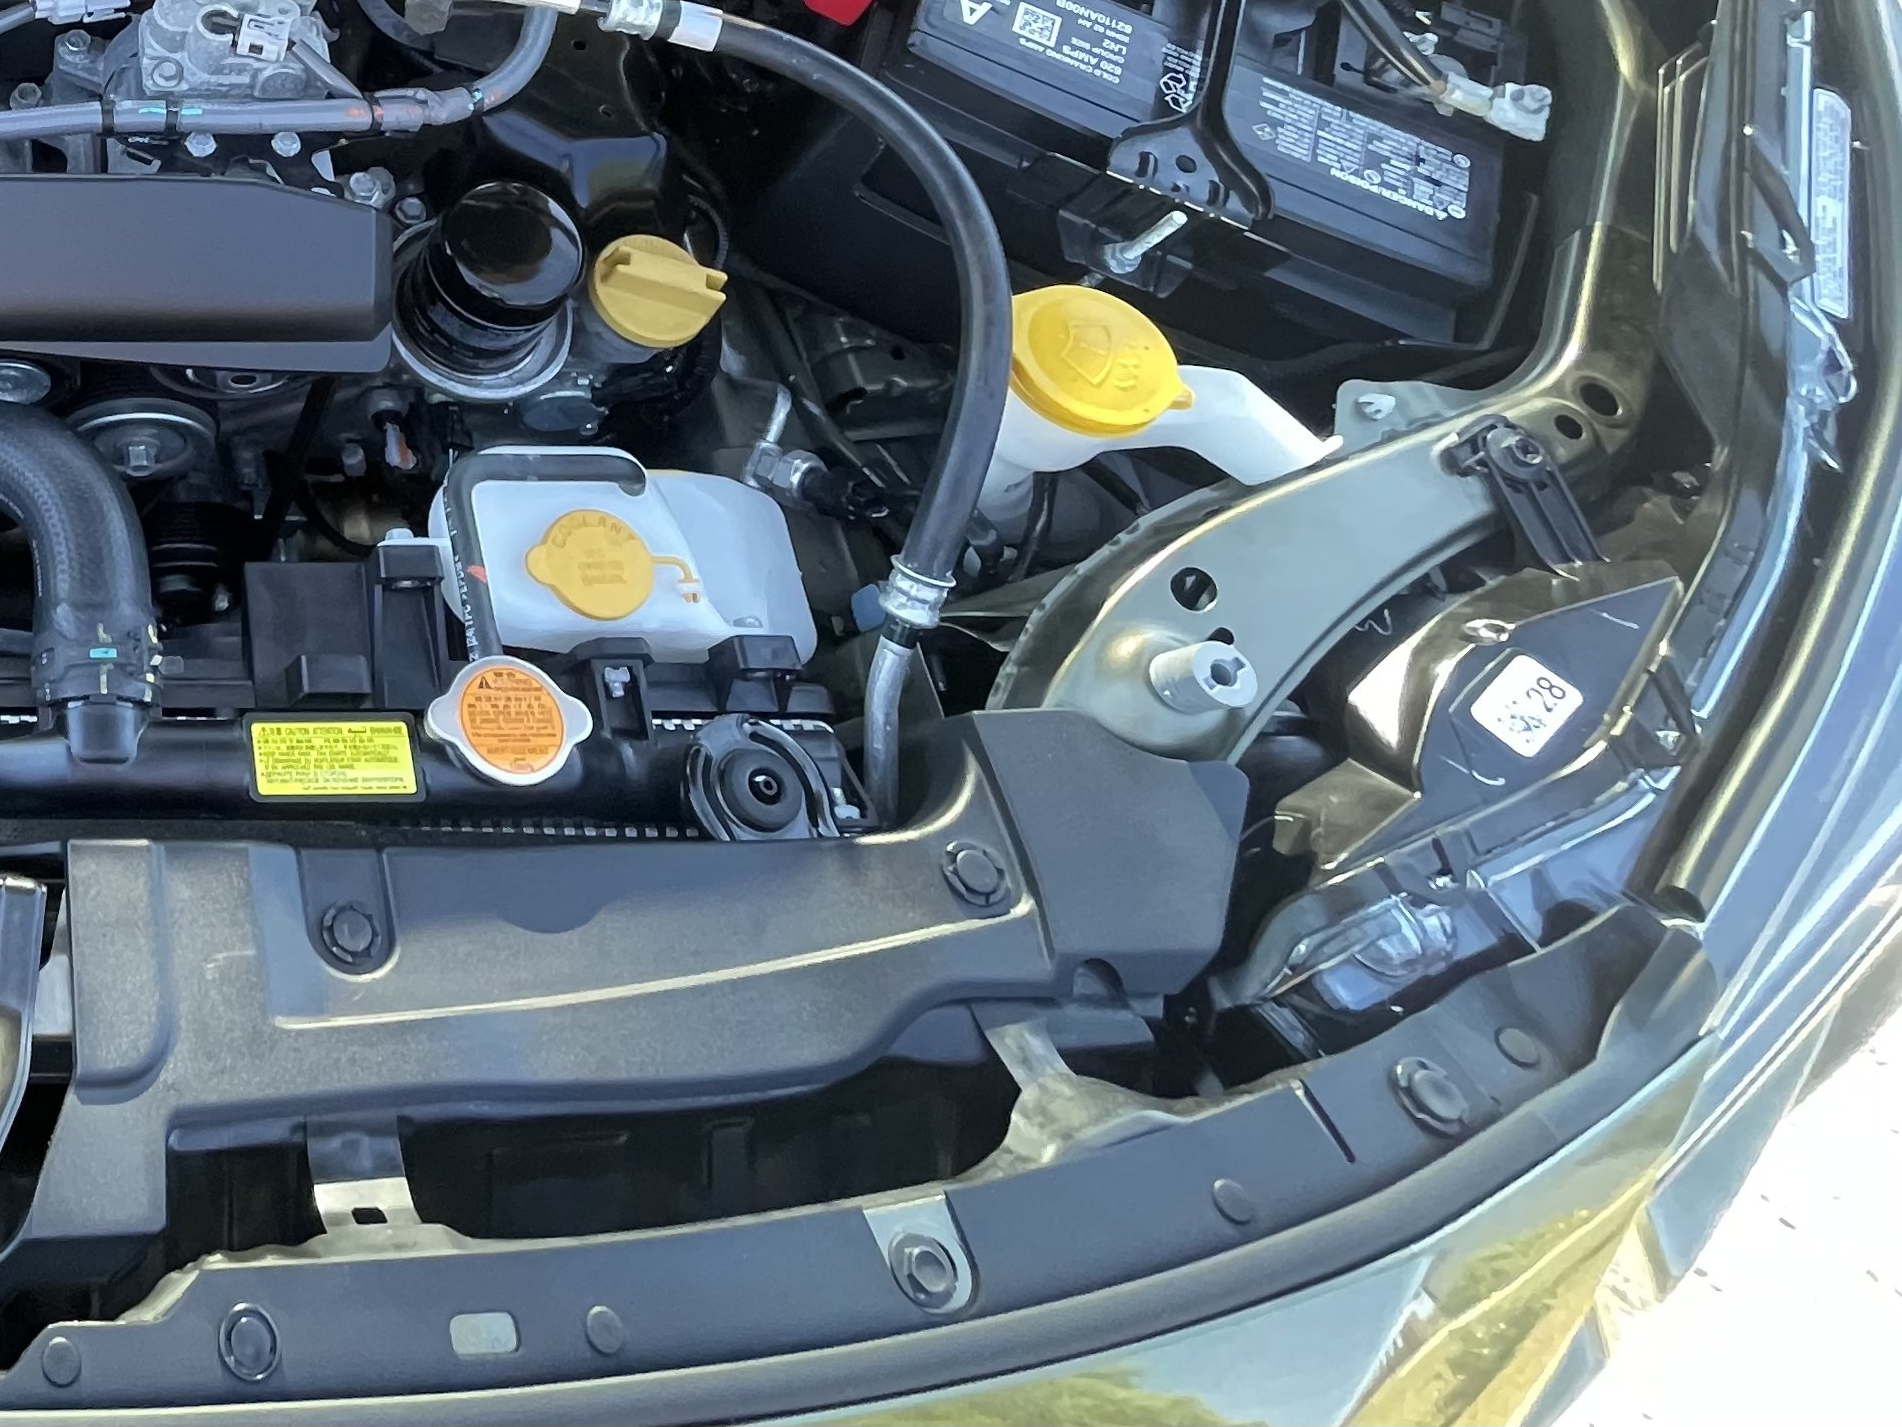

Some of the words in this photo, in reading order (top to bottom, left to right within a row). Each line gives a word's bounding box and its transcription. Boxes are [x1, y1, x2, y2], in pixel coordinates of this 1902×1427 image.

[1062, 44, 1099, 64] AMPS
[1102, 38, 1126, 55] LN2
[1526, 677, 1567, 713] 28
